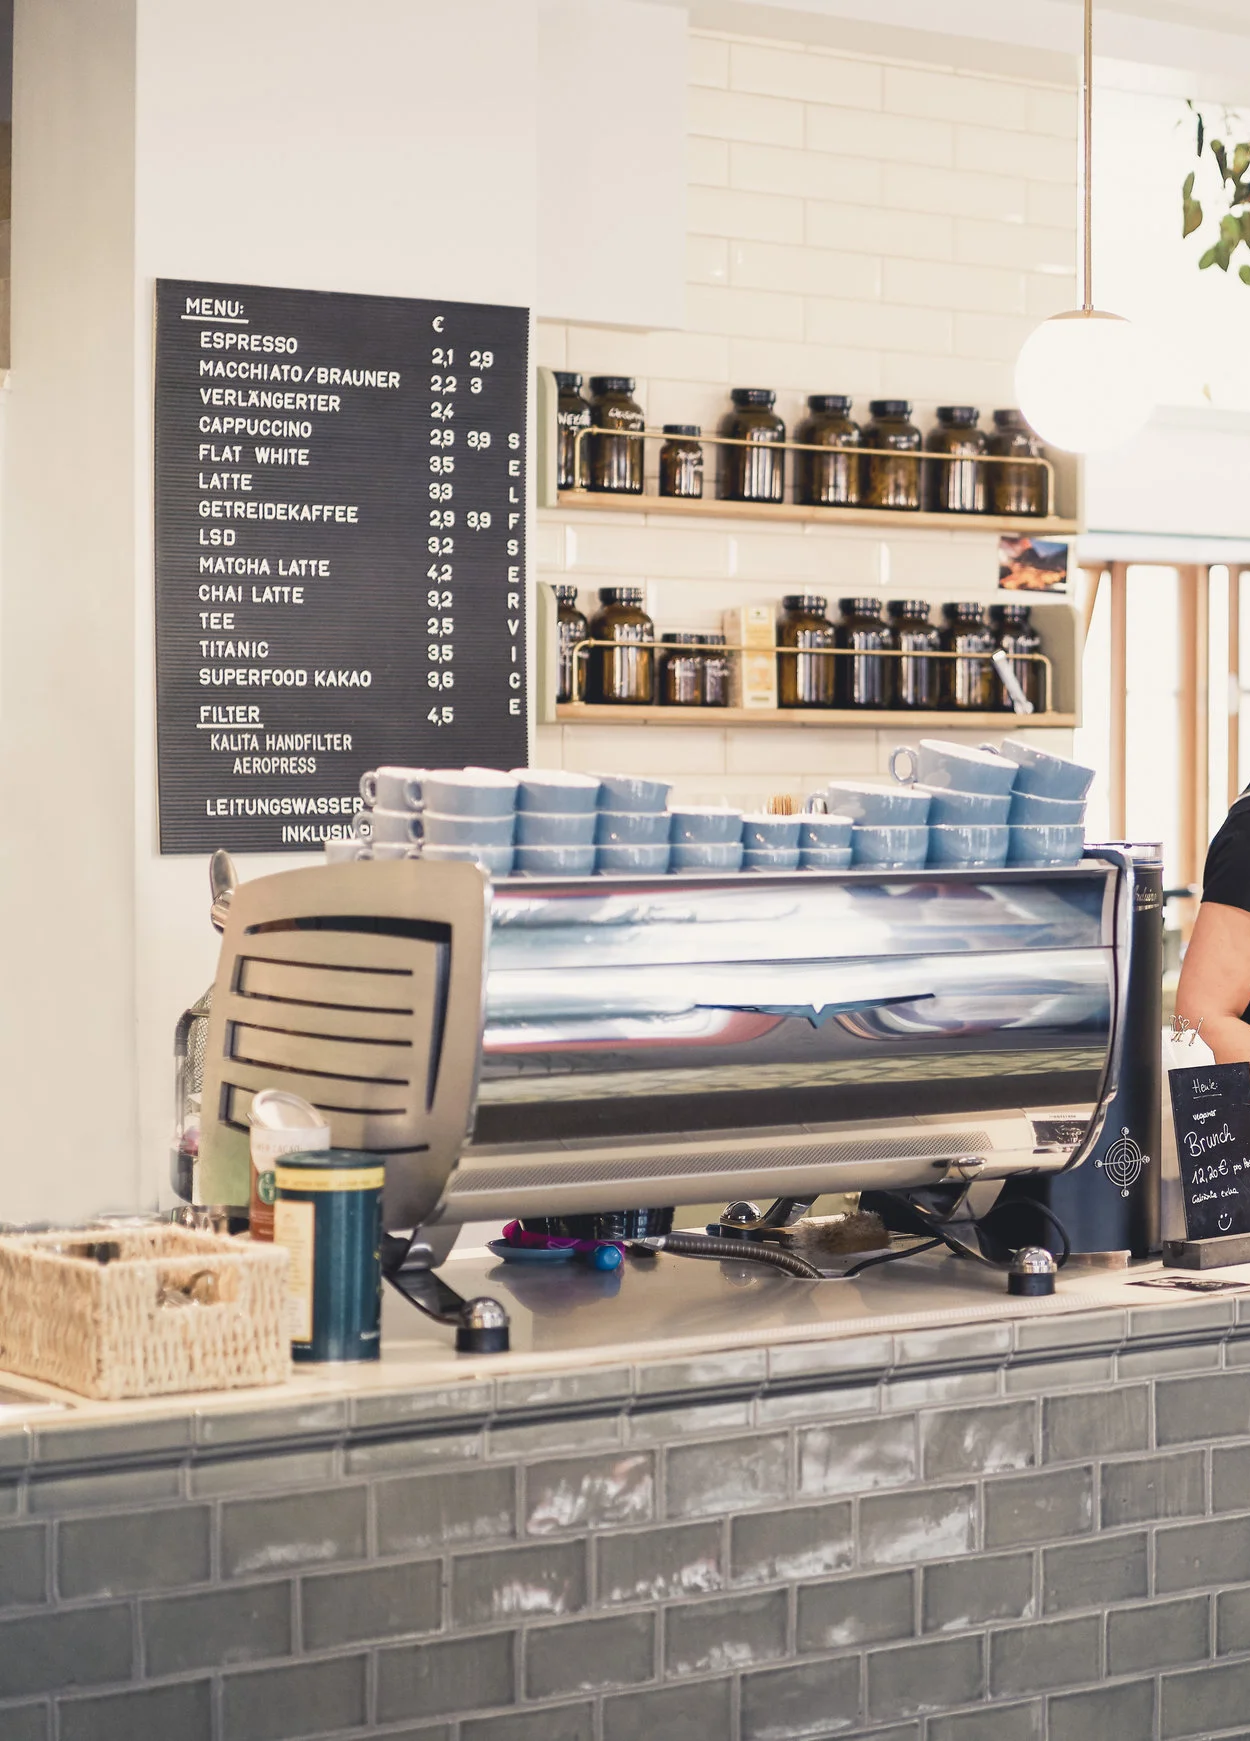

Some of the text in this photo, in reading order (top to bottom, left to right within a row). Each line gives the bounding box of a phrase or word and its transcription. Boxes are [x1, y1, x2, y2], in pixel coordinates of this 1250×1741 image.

[187, 298, 243, 315] MENU:
[201, 332, 493, 370] ESPRESSO 2,1 2,9
[200, 360, 482, 395] MACCHIATO/BRAUNER 2,2 3
[200, 388, 454, 422] VERLÄNGERTER 2,4
[199, 416, 490, 450] CAPPUCCINO 2,9 3,9
[199, 444, 454, 475] FLAT WHITE 3,5
[199, 473, 452, 503] LATTE 3,3
[199, 501, 491, 531] GETREIDEKAFFEE 2,9 3,9
[200, 529, 453, 556] LSD 3,2
[200, 557, 452, 583] MATCHA LATTE 4,2
[199, 585, 452, 610] CHAI LATTE 3,2
[199, 613, 453, 637] TEE 2,5
[199, 641, 453, 664] TITANIC 3,5
[199, 668, 453, 691] SUPERFOOD KAKAO 3,6
[200, 706, 453, 726] FILTER 4,5
[211, 733, 352, 751] KALITA HANDFILTER
[233, 757, 316, 774] AEROPRESS
[206, 797, 364, 816] LEITUNGSWASSER
[1184, 1123, 1236, 1157] Brunch
[1191, 1159, 1229, 1184] 12,20€
